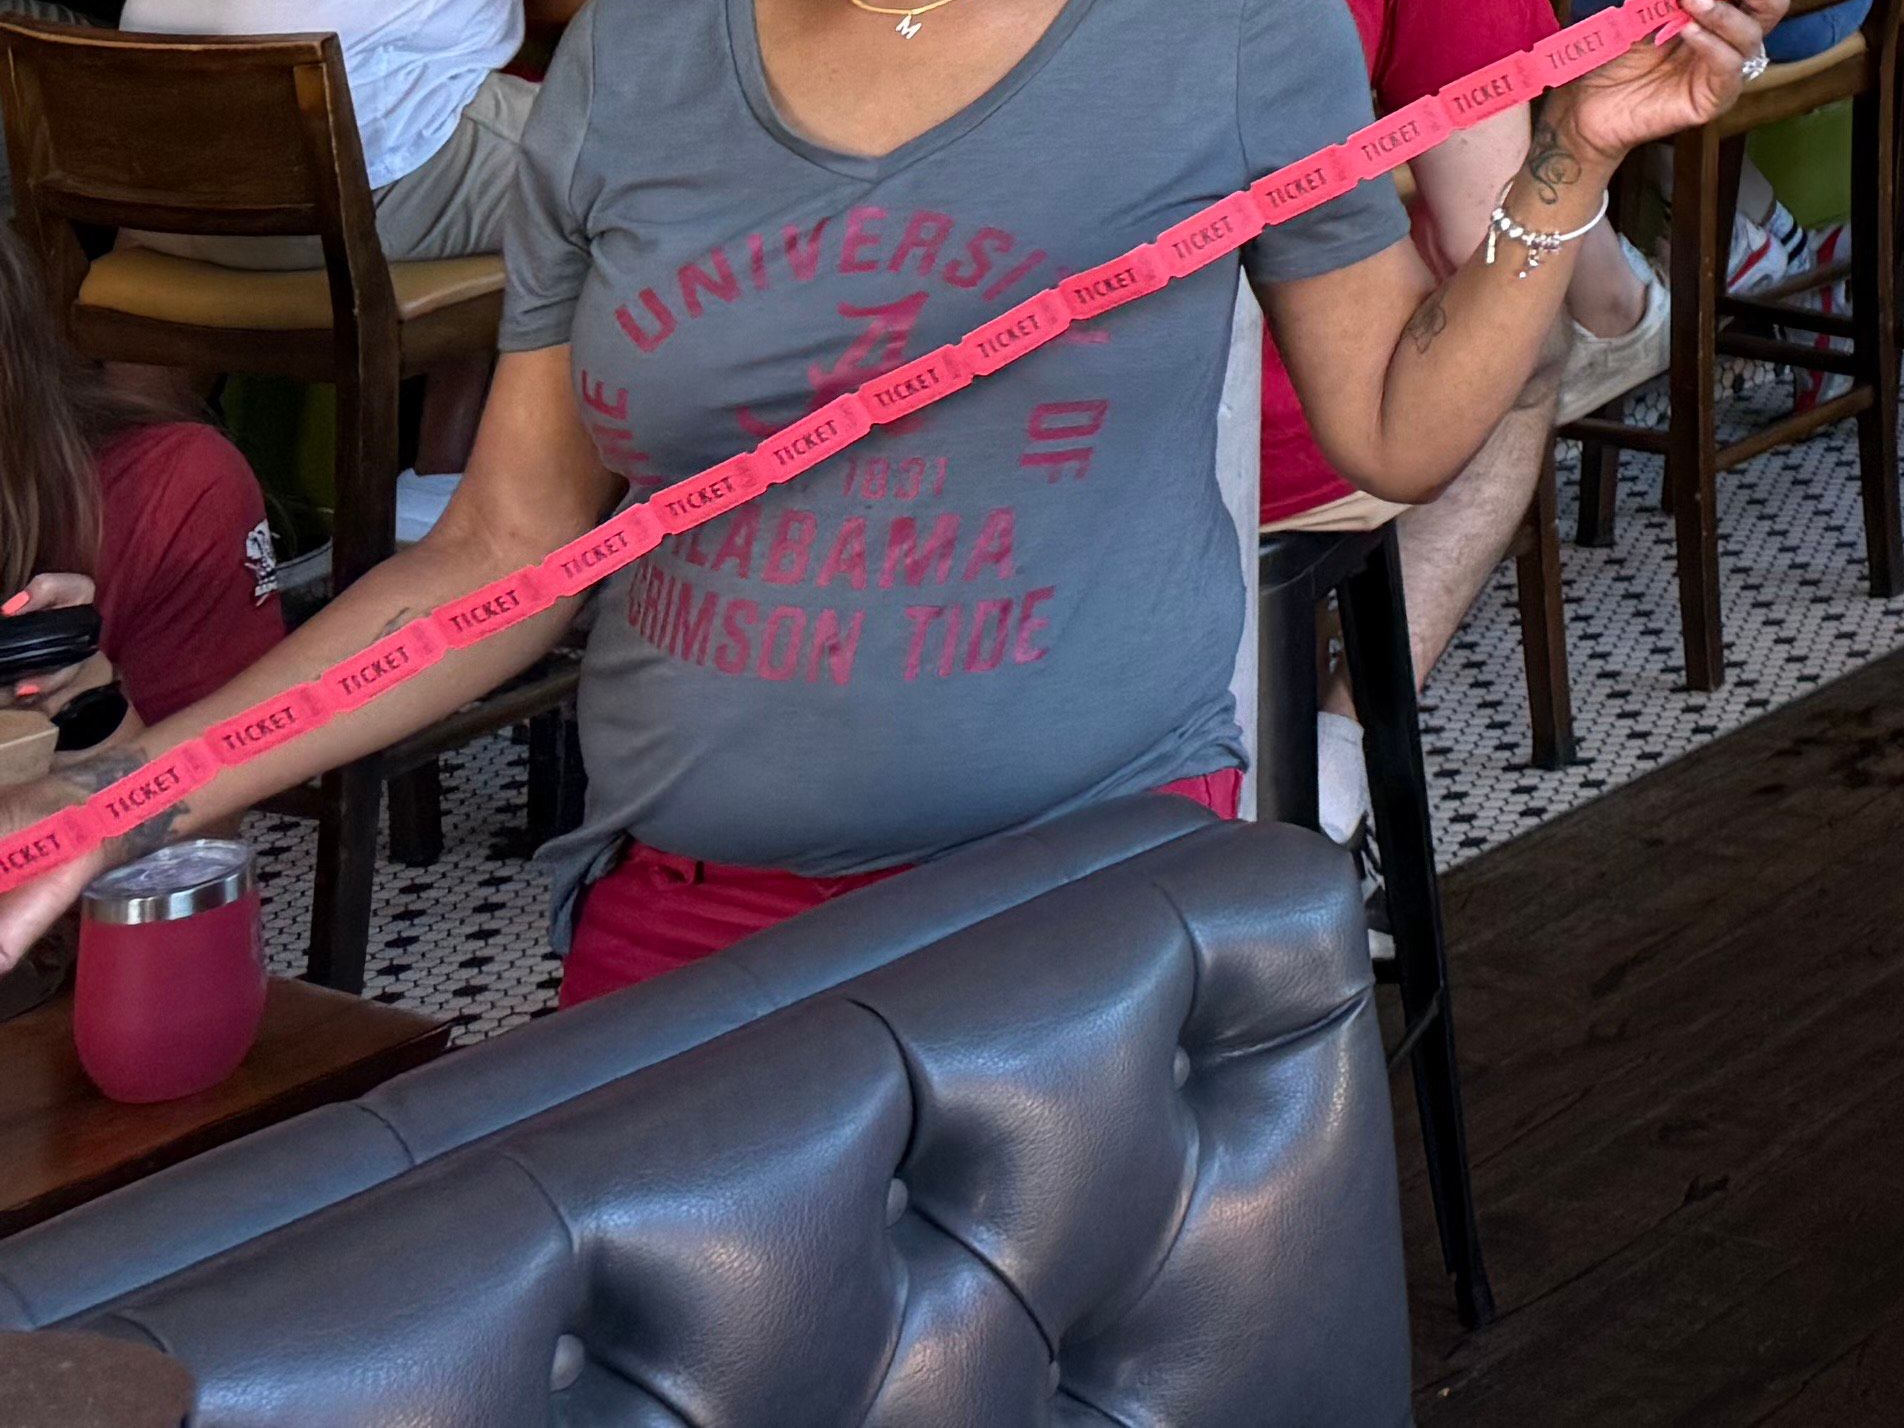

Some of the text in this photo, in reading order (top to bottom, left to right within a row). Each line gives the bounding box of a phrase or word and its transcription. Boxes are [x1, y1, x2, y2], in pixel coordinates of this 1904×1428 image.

[1545, 30, 1606, 71] TICKET
[1452, 74, 1515, 113] TICKET
[1360, 119, 1421, 162] TICKET
[1264, 167, 1328, 209] TICKET
[1171, 215, 1235, 260] TICKET
[614, 205, 1048, 354] UNIVERSI
[1074, 268, 1138, 306] TICKET
[976, 315, 1042, 358] TICKET
[874, 369, 940, 409] TICKET
[773, 420, 840, 468] TICKET
[1019, 398, 1111, 484] OF
[664, 475, 735, 519] TICKET
[842, 456, 948, 500] 1831
[561, 530, 630, 580] TICKET
[448, 589, 522, 635] TICKET
[628, 558, 1058, 687] CRIMSON TIDE
[337, 645, 411, 698] TICKET
[222, 705, 298, 752] TICKET
[105, 767, 181, 821] TICKET
[0, 833, 62, 876] ICKET
